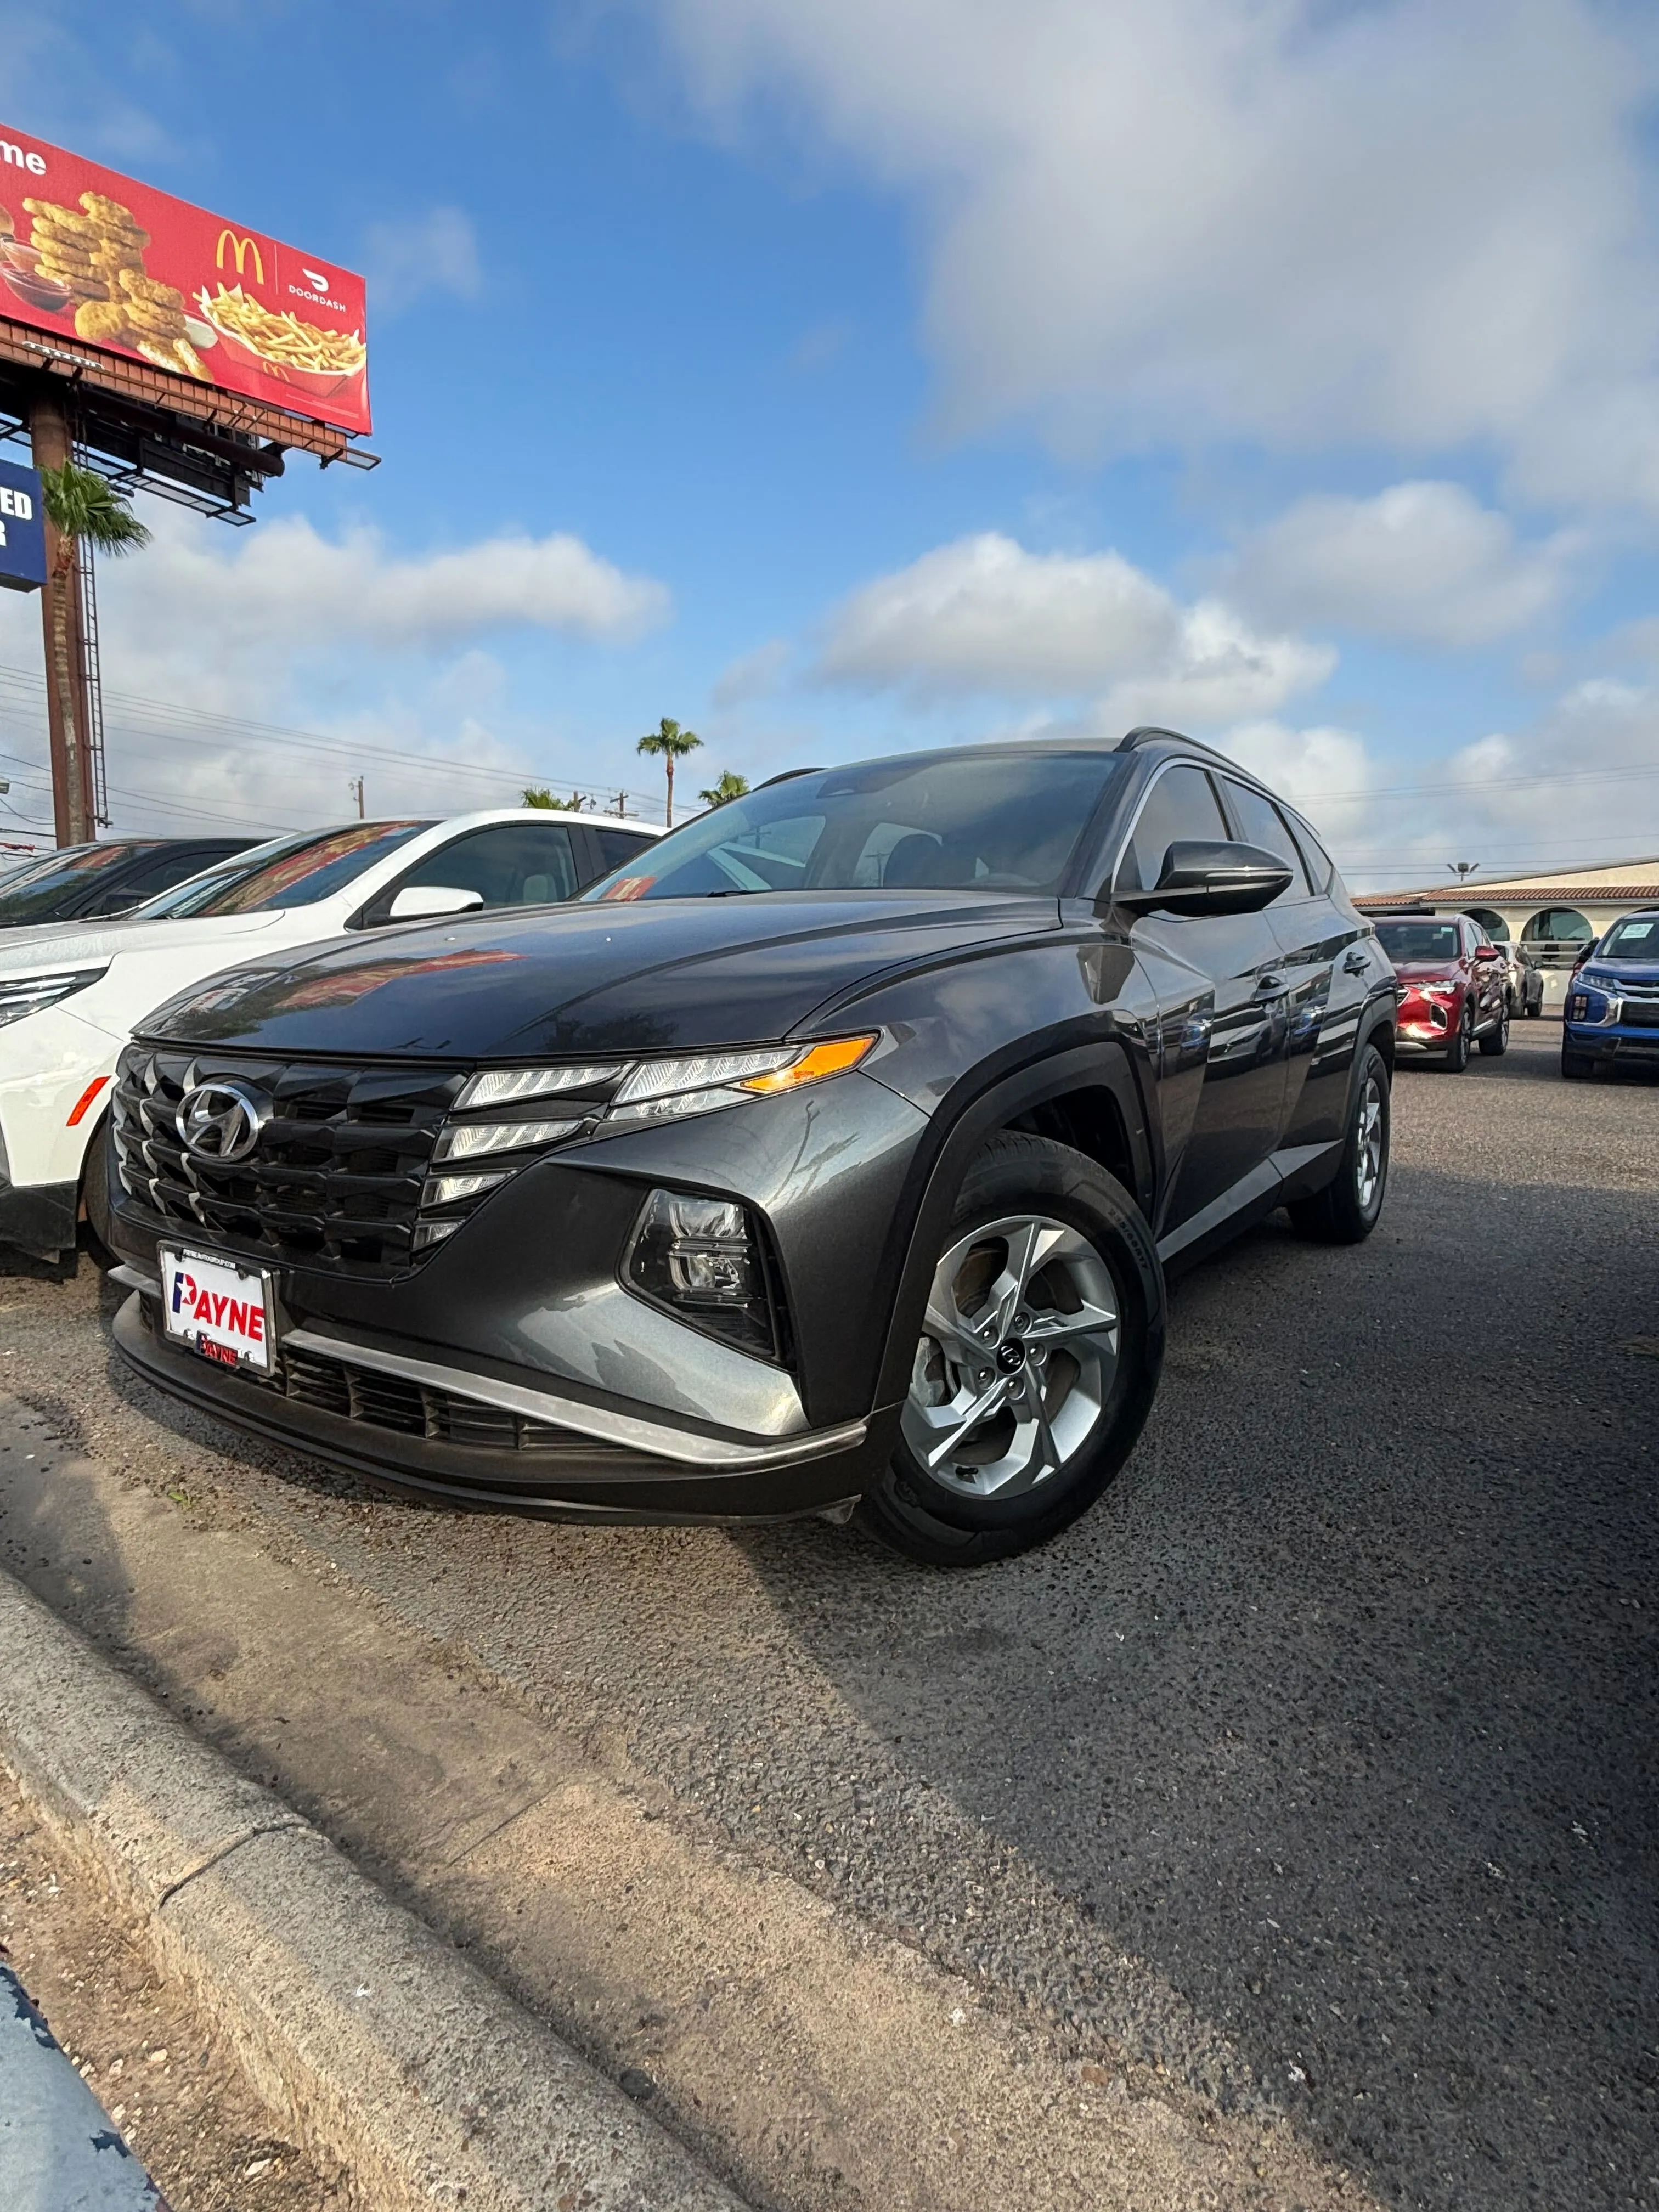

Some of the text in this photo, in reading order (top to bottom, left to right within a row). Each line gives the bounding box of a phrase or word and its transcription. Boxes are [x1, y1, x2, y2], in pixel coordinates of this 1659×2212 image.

[289, 284, 347, 313] DOORDASH
[172, 1271, 266, 1342] PAYNE
[195, 1330, 239, 1367] PAYNE
